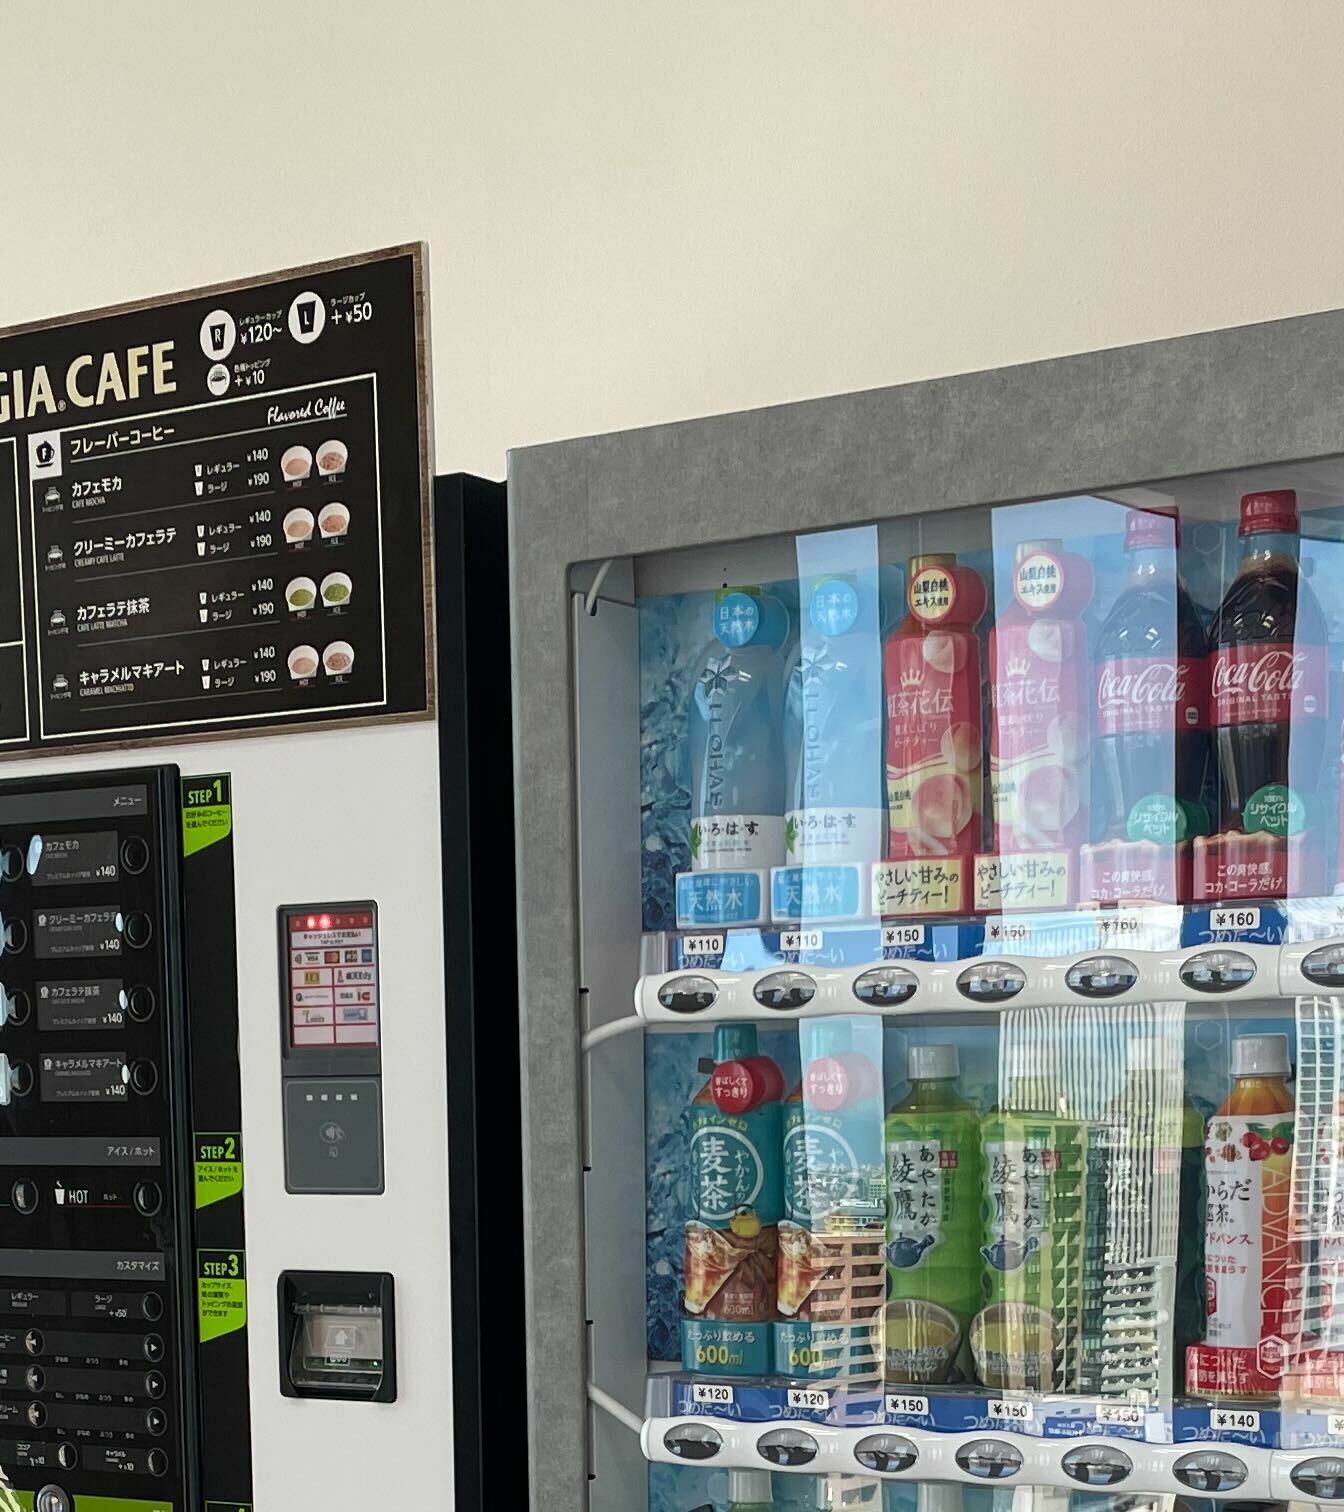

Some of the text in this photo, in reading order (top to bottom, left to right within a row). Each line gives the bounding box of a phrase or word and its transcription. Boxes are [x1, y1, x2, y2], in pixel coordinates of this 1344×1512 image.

[66, 340, 177, 409] CAFE
[267, 399, 345, 424] Flavored Coffee
[70, 427, 174, 455] フレーバーコーヒー
[72, 476, 122, 497] カフェモカ
[74, 528, 177, 556] クリーミーカフェラテ
[77, 598, 151, 620] カフェラテ抹茶
[79, 661, 185, 684] キャラメルマキアート
[113, 795, 142, 807] メニュー
[689, 890, 742, 911] 天然水
[1216, 912, 1254, 926] ¥160
[689, 937, 719, 950] ¥110
[886, 928, 920, 942] ¥150
[700, 1137, 732, 1209] 麦茶
[69, 1189, 88, 1204] HOT
[892, 1154, 918, 1223] 綾鷹
[918, 1145, 936, 1227] あやたか
[116, 1260, 159, 1272] カスタマイズ
[696, 1347, 742, 1365] 600ml
[698, 1388, 729, 1400] ¥120
[891, 1398, 924, 1411] ¥150
[1217, 1414, 1255, 1427] ¥140
